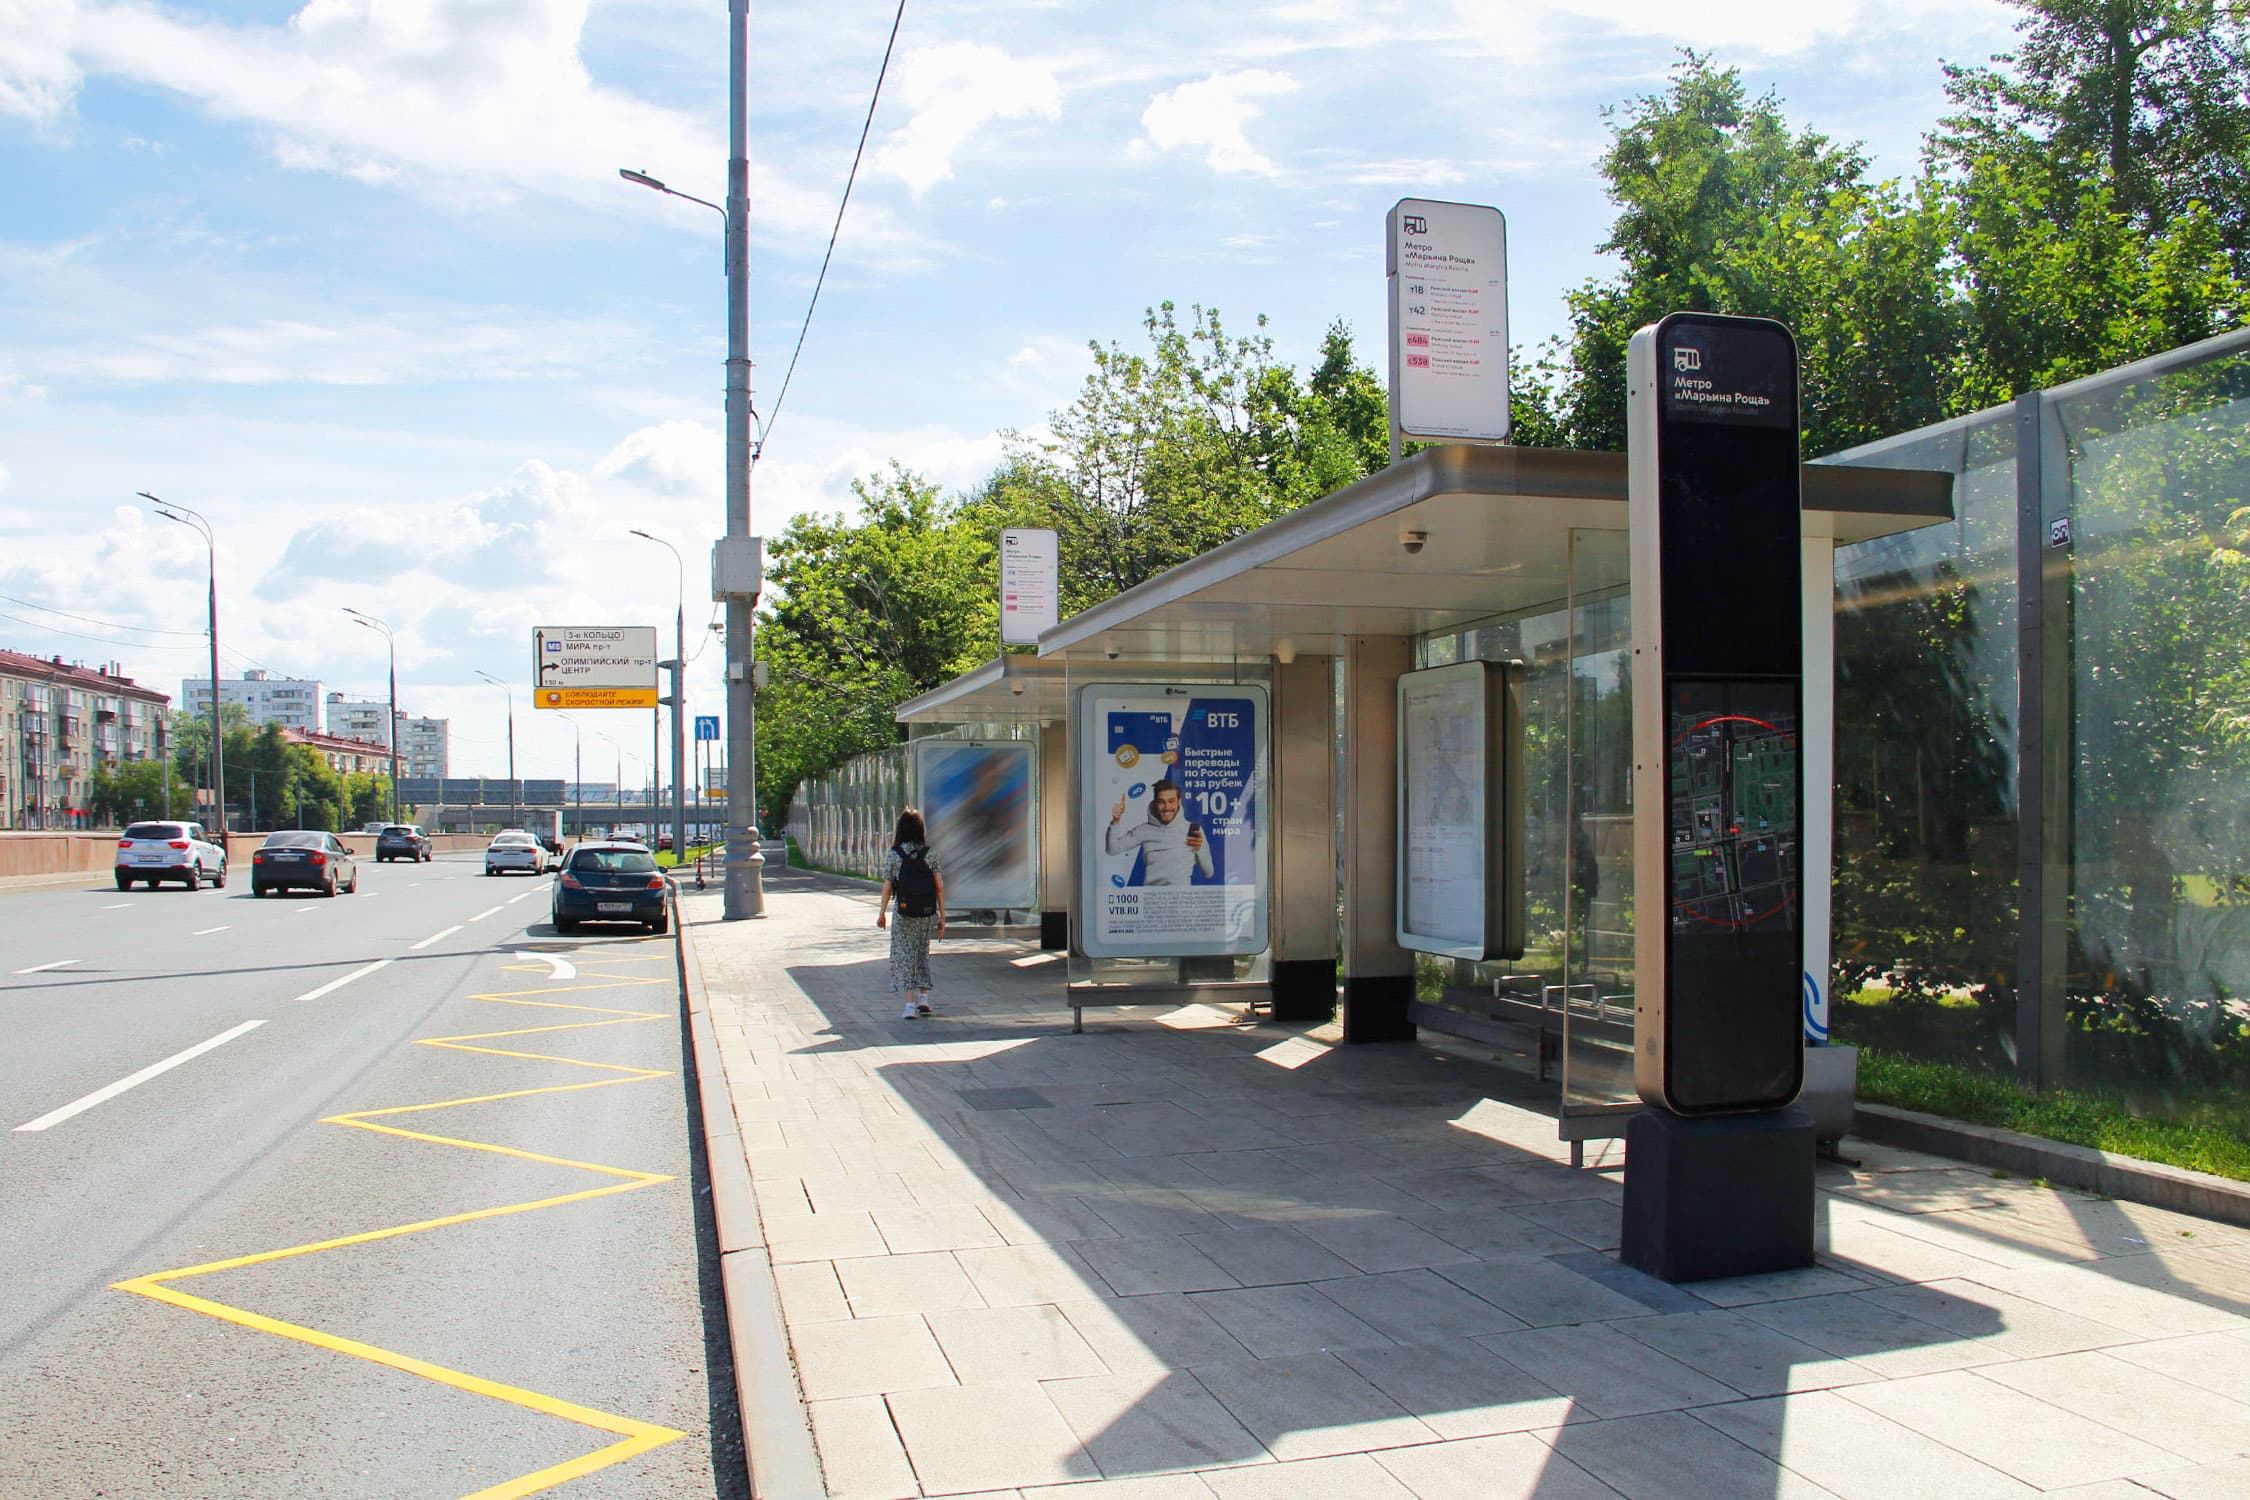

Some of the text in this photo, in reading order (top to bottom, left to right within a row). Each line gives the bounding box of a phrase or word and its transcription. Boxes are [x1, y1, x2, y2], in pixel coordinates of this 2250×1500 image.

[1404, 242, 1433, 252] Метро
[1405, 251, 1475, 265] «Марьина Роща»
[1674, 376, 1713, 390] Метро
[1675, 389, 1770, 407] «Марьина Роща»
[583, 631, 621, 640] КОЛЬЦО
[561, 656, 630, 665] ОЛИМПИЙСКИЙ
[1207, 713, 1239, 728] ВТБ
[1184, 747, 1233, 758] Быстрые
[1184, 759, 1240, 769] переводы
[1201, 768, 1238, 777] России
[1184, 777, 1242, 790] и за рубеж
[1212, 817, 1243, 827] стран
[1212, 828, 1241, 836] мира
[1116, 894, 1138, 904] 1000
